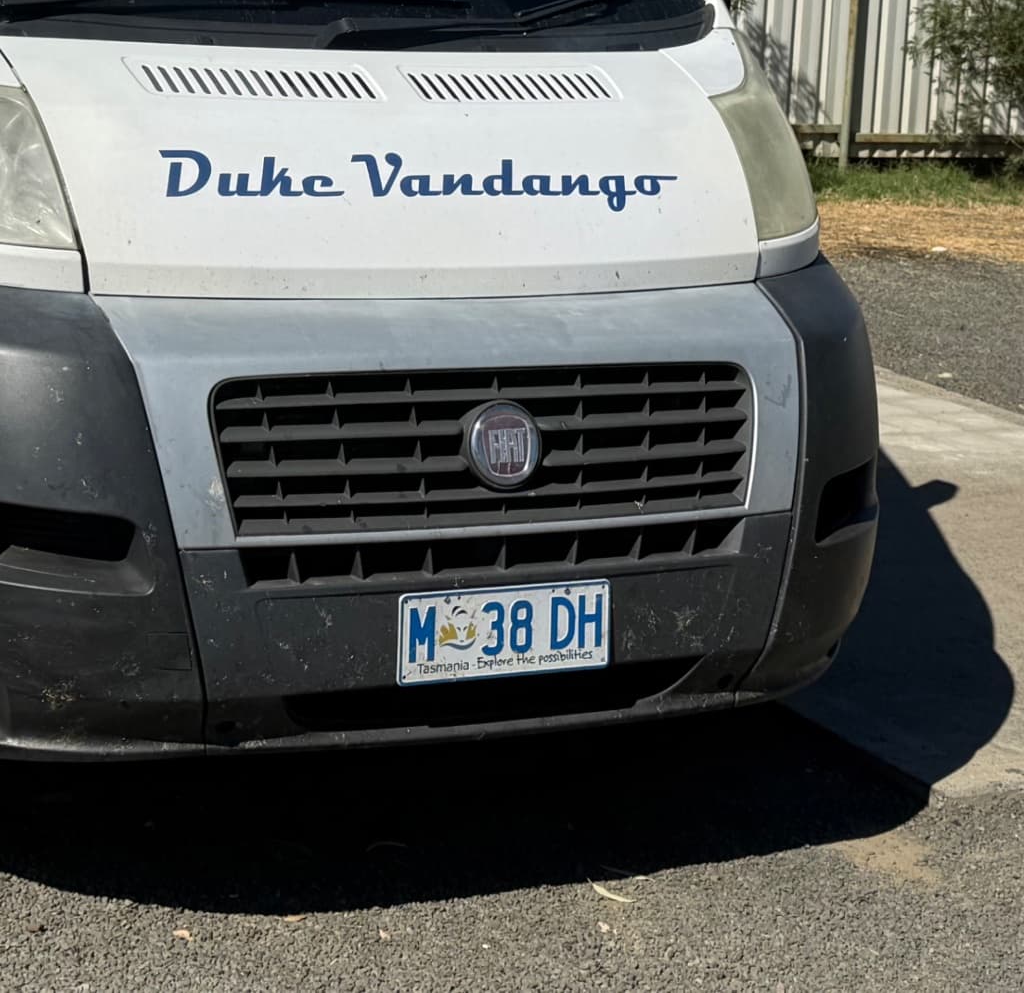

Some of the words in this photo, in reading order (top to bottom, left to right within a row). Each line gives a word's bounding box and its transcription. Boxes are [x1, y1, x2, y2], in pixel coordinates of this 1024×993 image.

[158, 149, 345, 198] Duke
[351, 153, 678, 212] Vandango
[408, 606, 436, 663] M
[481, 600, 534, 656] 38
[550, 593, 604, 651] DH
[417, 662, 470, 675] Tasmania
[477, 656, 514, 670] Explore
[516, 652, 537, 666] the
[538, 649, 593, 665] possibilities
